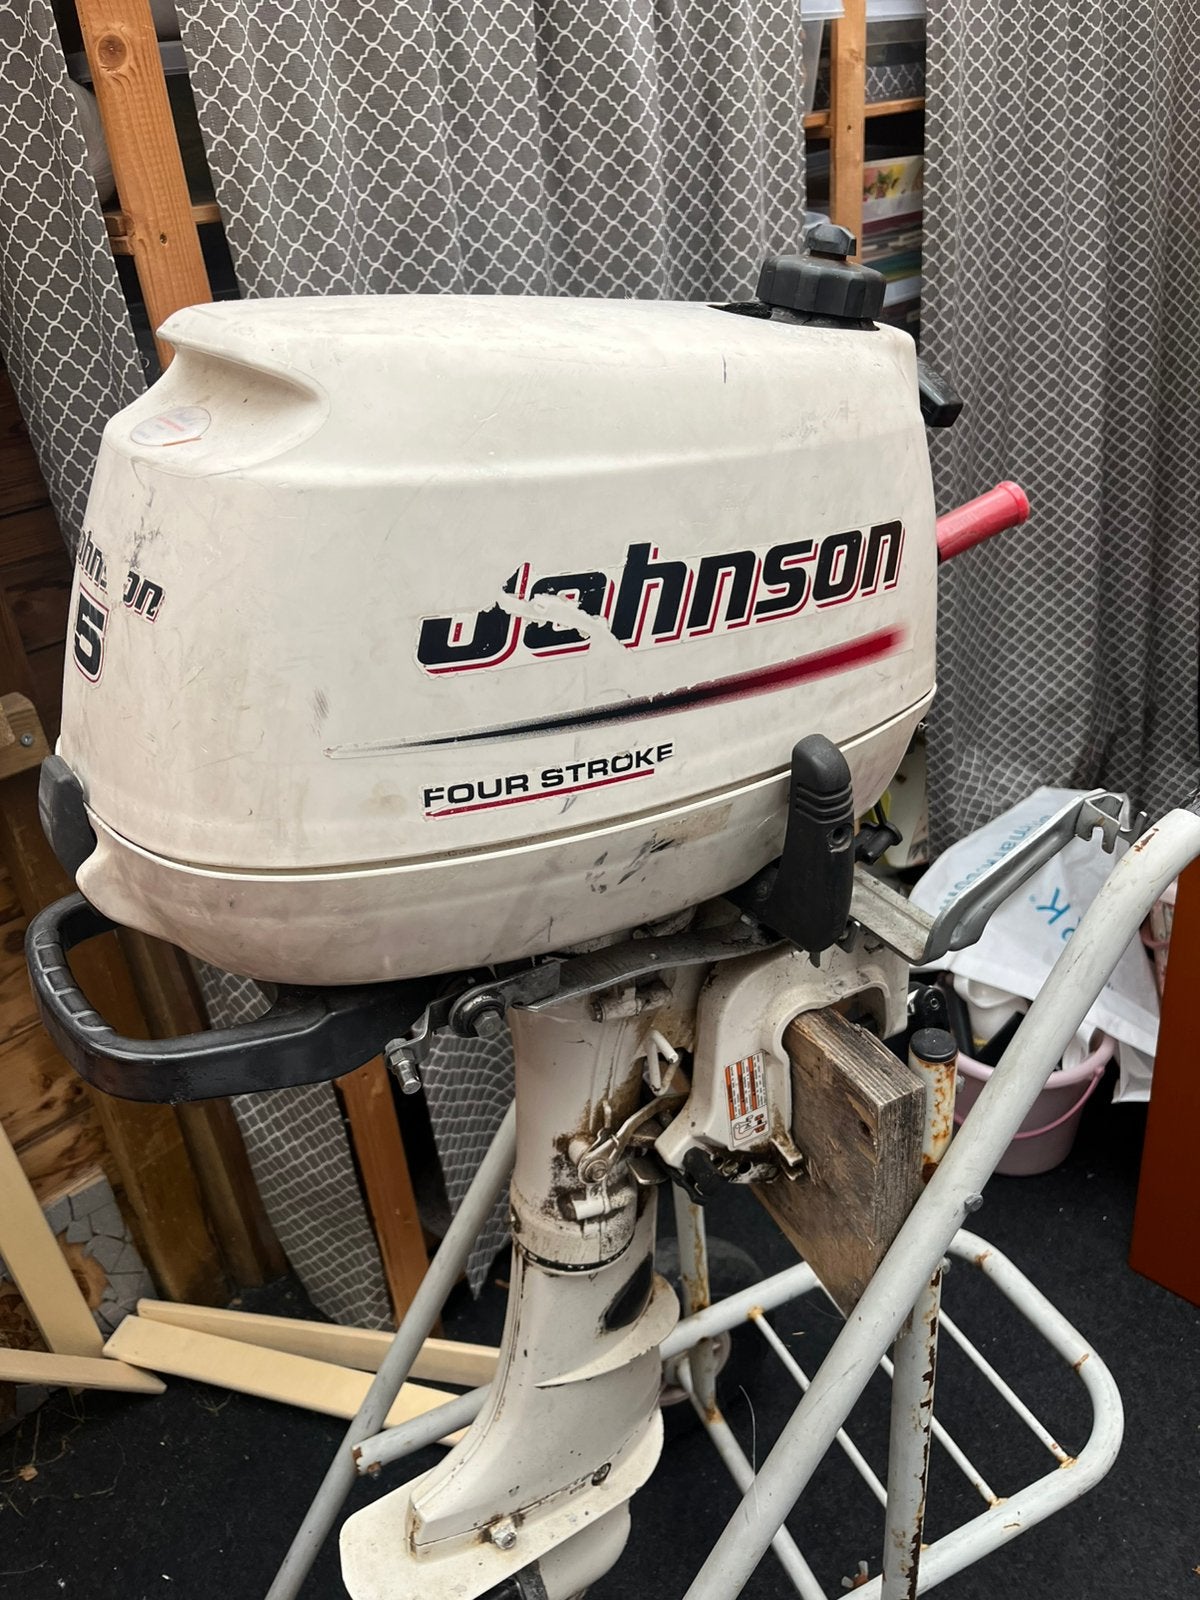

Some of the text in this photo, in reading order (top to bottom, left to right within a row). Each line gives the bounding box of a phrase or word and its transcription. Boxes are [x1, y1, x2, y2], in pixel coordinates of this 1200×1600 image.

[74, 590, 106, 679] 5
[417, 519, 905, 673] Johnson
[423, 742, 673, 808] FOUR STROKE
